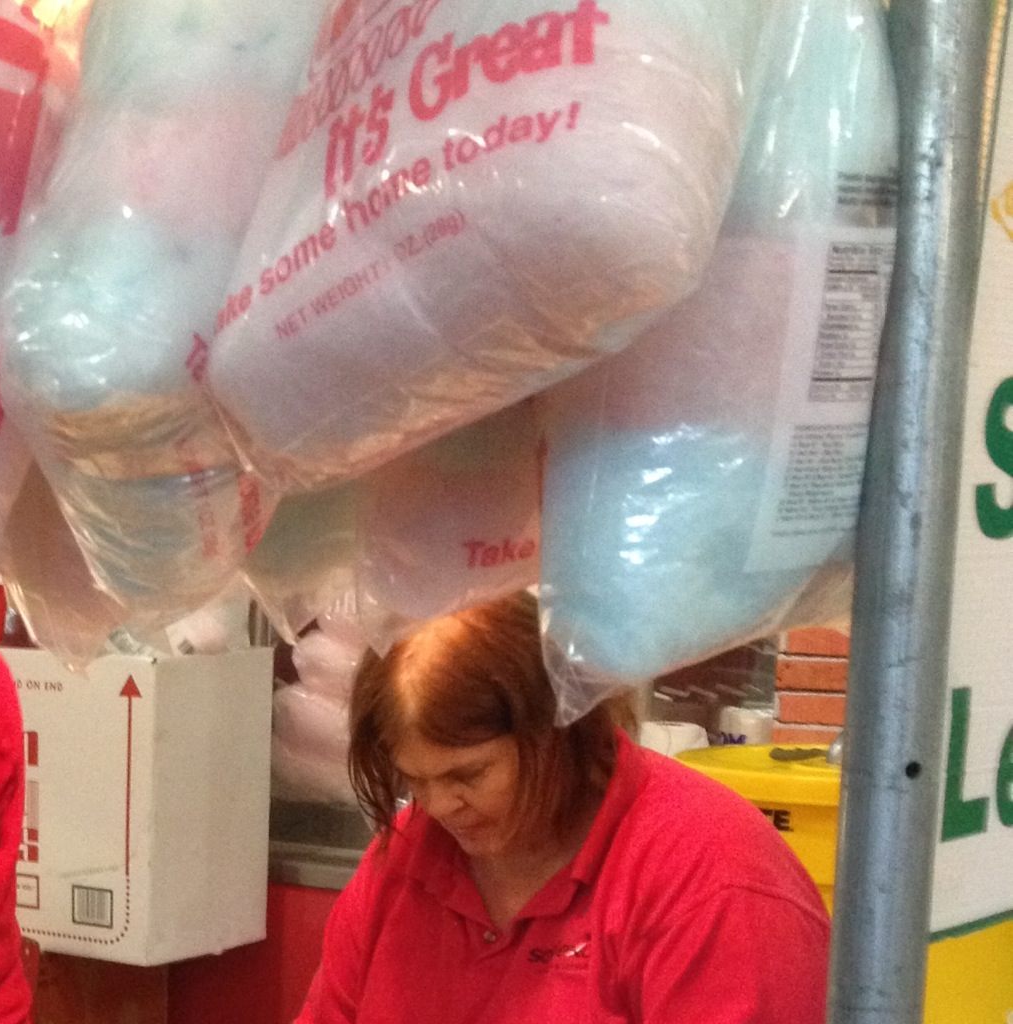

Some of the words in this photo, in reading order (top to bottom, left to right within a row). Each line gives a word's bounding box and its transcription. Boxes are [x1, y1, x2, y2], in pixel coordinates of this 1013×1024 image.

[259, 223, 336, 297] some
[344, 156, 432, 234] home
[441, 100, 582, 173] today!
[324, 83, 394, 200] it's
[409, 0, 610, 122] Great
[464, 537, 535, 569] Take
